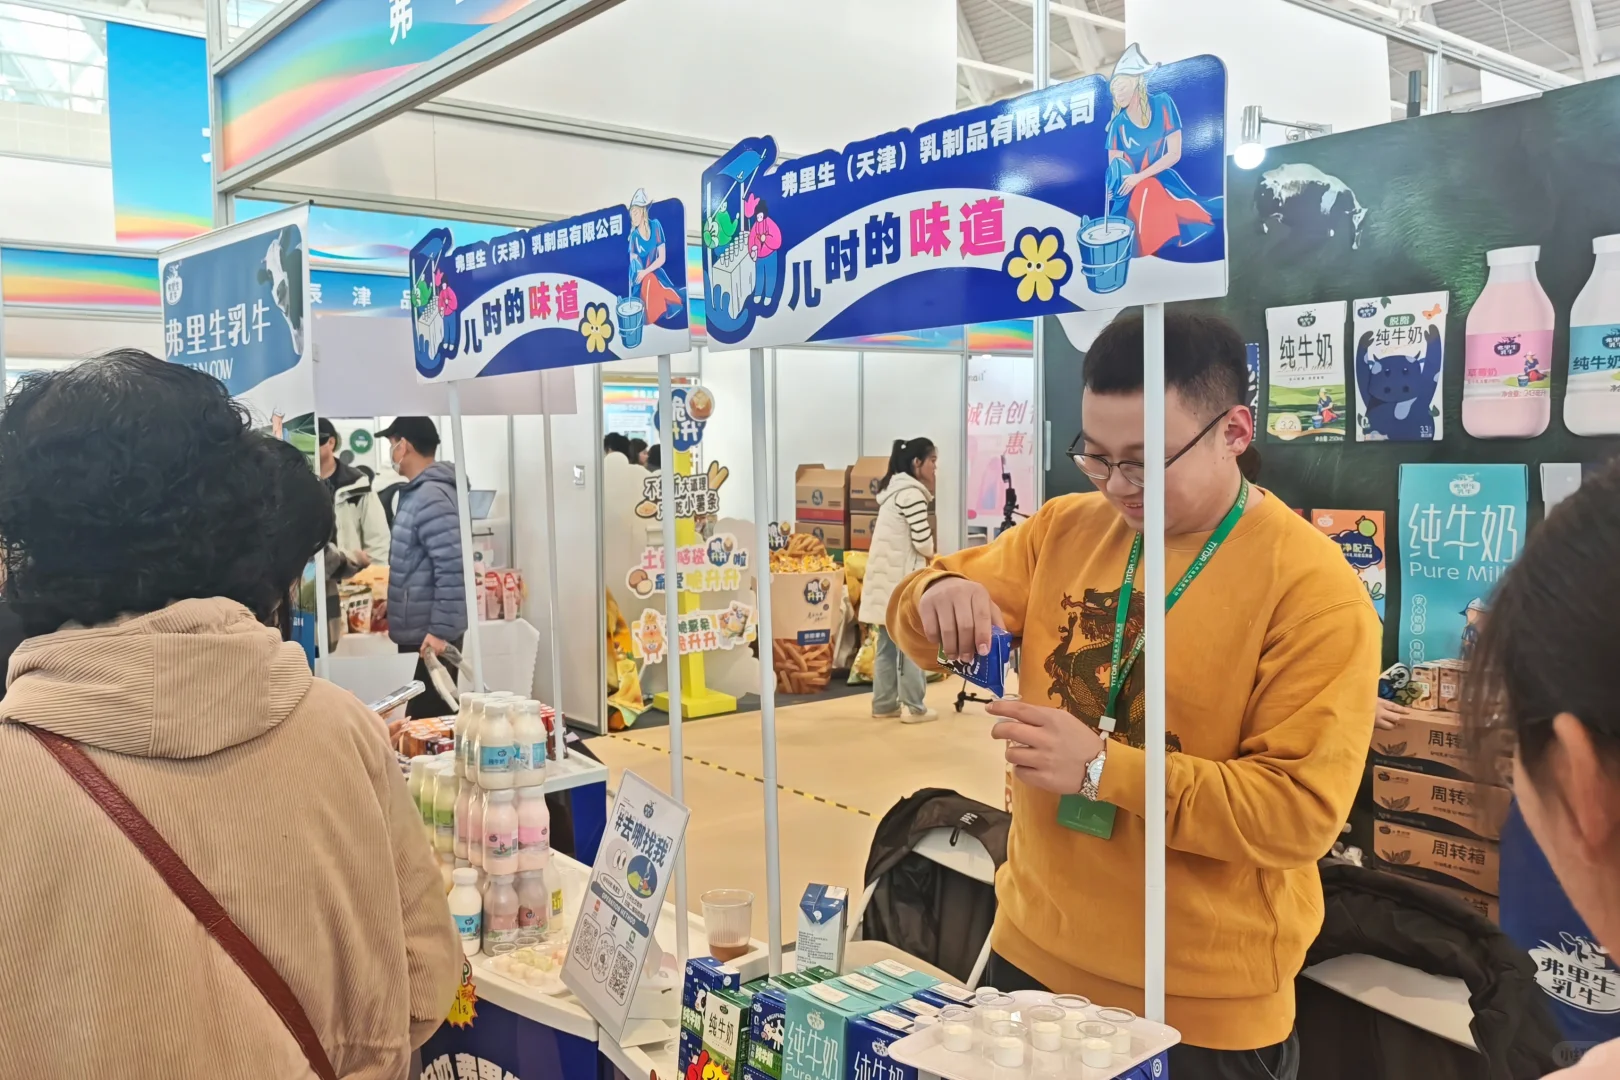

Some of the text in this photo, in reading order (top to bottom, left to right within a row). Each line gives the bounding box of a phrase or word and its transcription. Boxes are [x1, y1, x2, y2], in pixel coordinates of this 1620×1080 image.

[780, 91, 1096, 198] 弗里生（天津）乳制品有限公司
[455, 214, 623, 274] 弗里生（天津）乳制品有限公司
[788, 197, 1006, 311] 儿时的味道
[165, 299, 271, 358] 弗里生乳牛
[463, 280, 580, 355] 儿时的味道
[1279, 332, 1333, 368] 纯牛奶
[1375, 326, 1423, 346] 纯牛奶
[1572, 355, 1620, 371] 纯牛奶
[1006, 430, 1033, 455] 惠
[1408, 503, 1518, 562] 纯牛奶
[1124, 563, 1135, 584] TITOR
[1409, 561, 1459, 580] Pure
[1431, 785, 1470, 806] 周转
[615, 811, 669, 868] #去哪找我
[1432, 839, 1486, 866] 周转箱
[1540, 957, 1616, 997] 弗里生
[1551, 977, 1601, 1005] 乳牛
[709, 1012, 734, 1046] 纯牛奶
[787, 1021, 839, 1079] 纯牛奶
